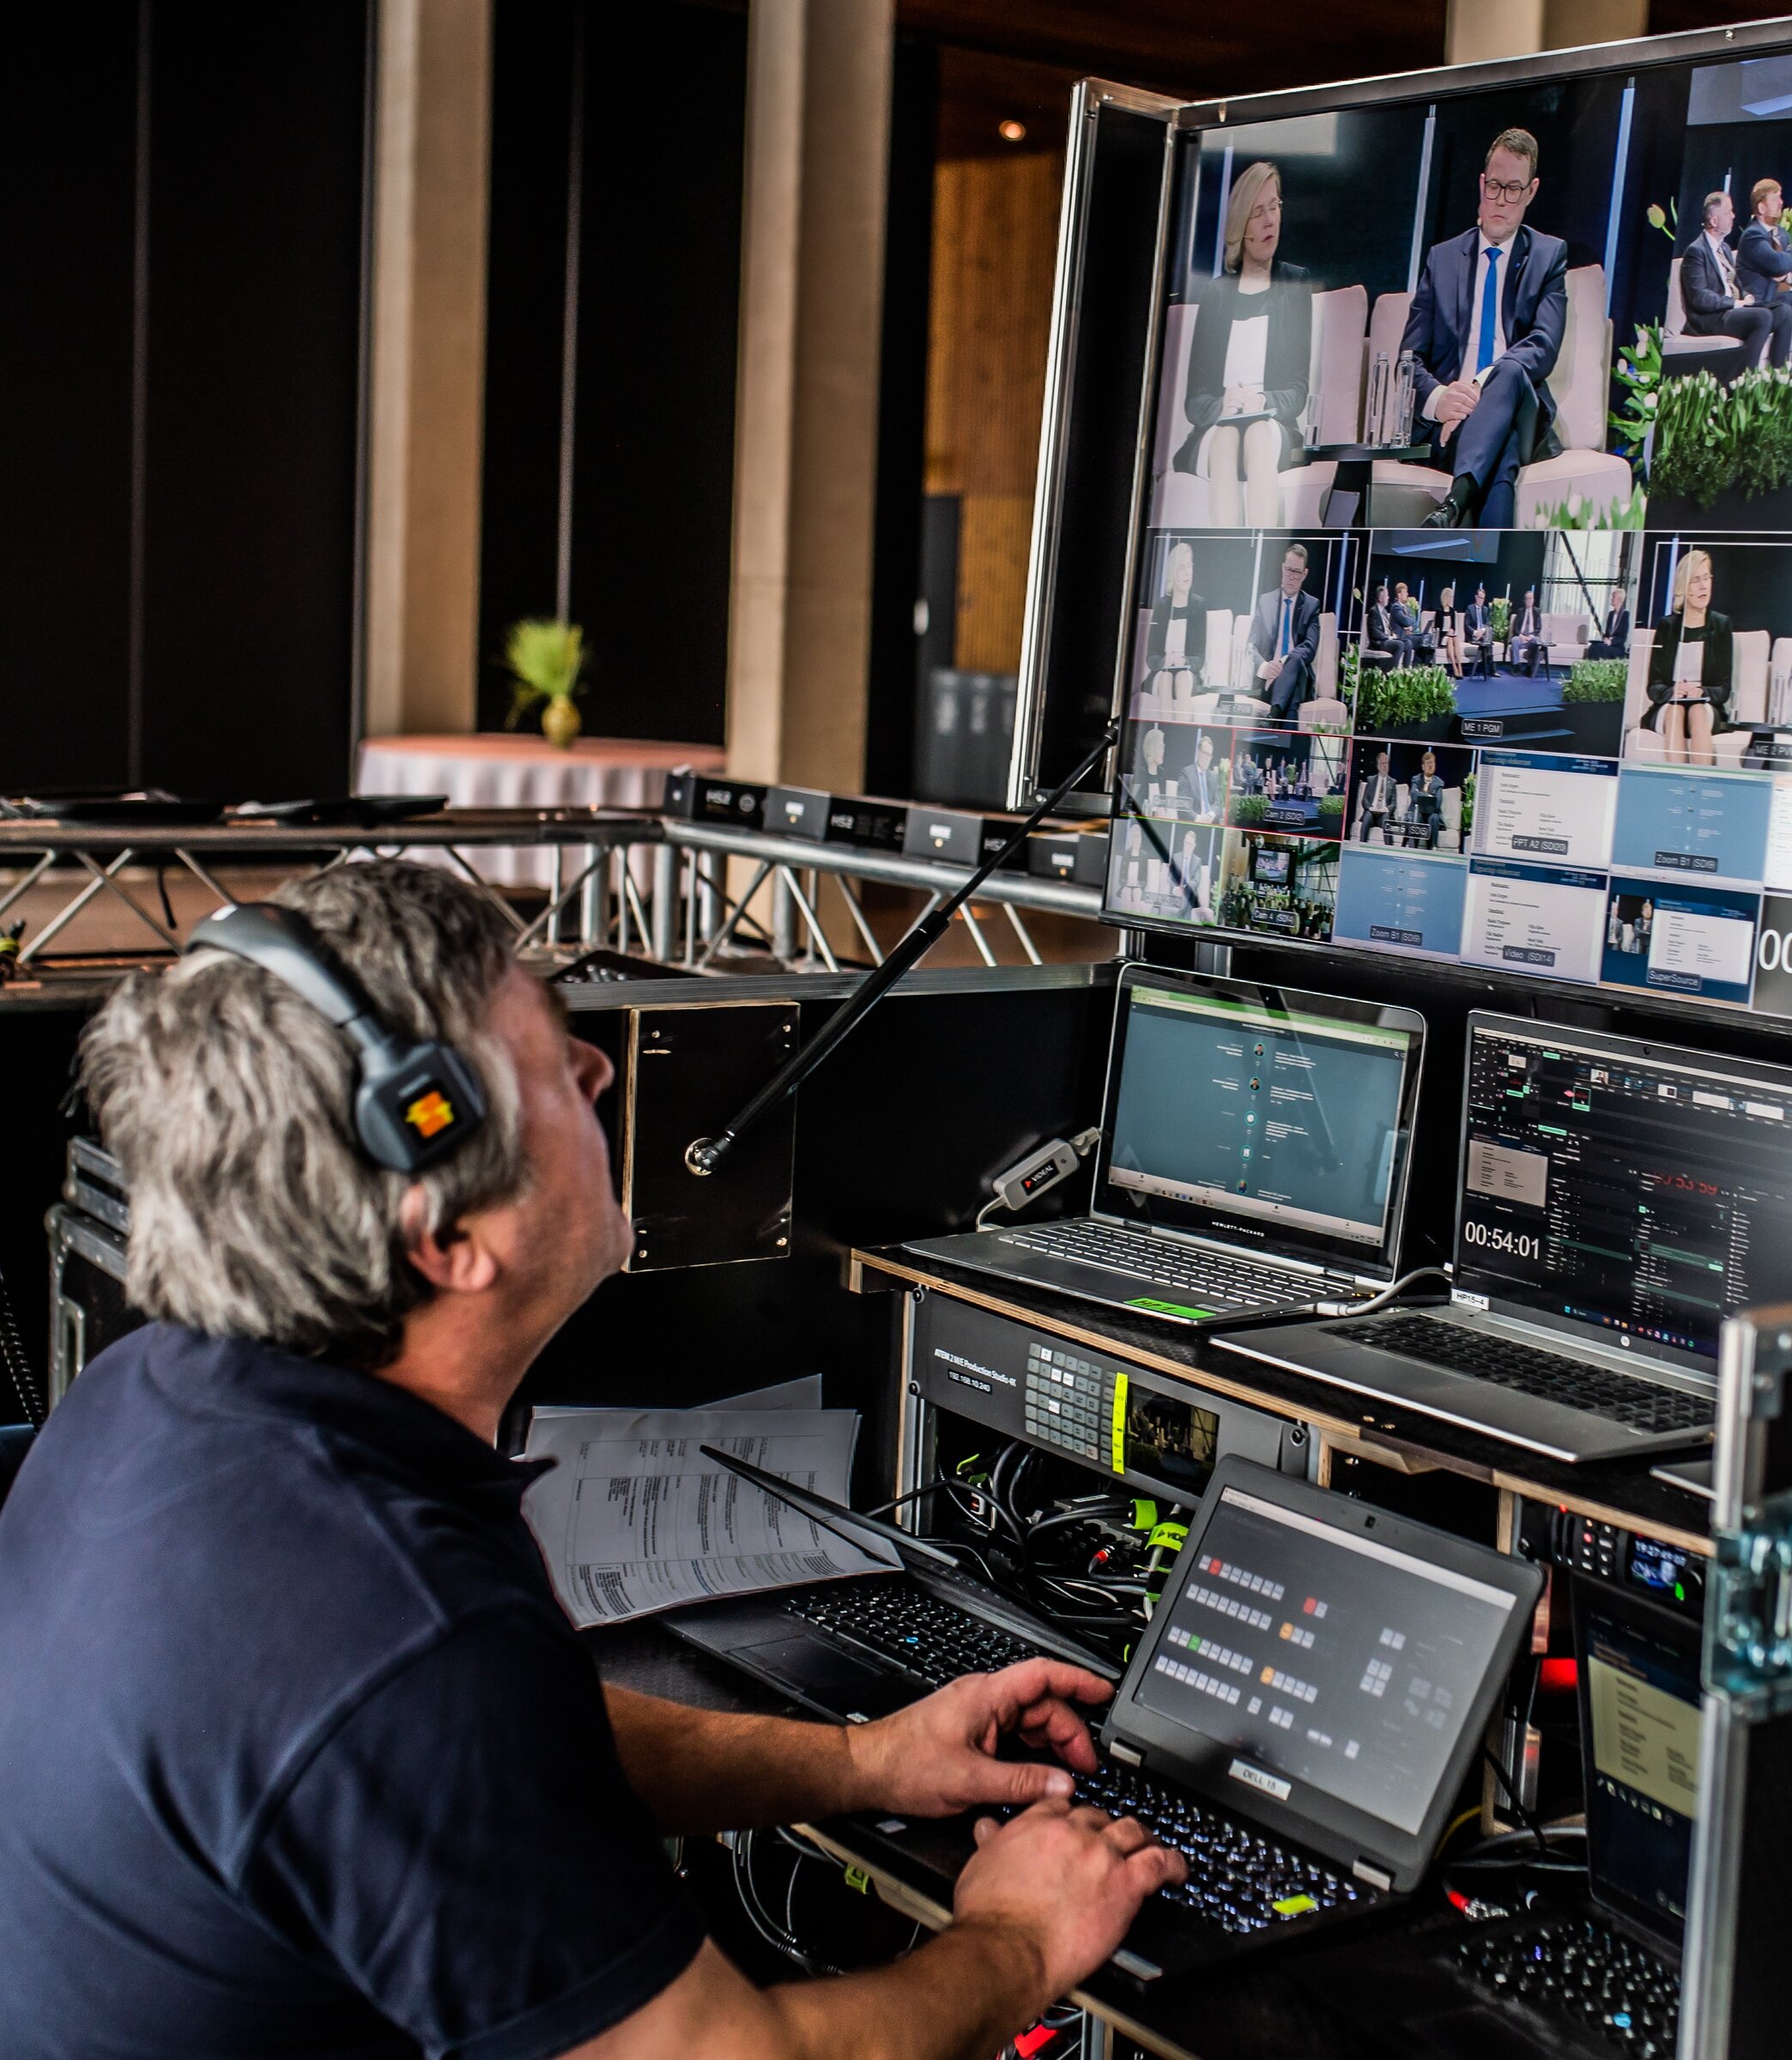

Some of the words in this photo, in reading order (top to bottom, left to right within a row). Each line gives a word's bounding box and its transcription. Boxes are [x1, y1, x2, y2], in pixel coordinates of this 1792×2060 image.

[1463, 723, 1475, 731] ME
[1482, 724, 1500, 734] PGM
[1755, 745, 1769, 754] ME
[1771, 747, 1777, 755] 2
[1264, 809, 1279, 818] Cam
[1384, 823, 1400, 833] Cam
[1400, 825, 1406, 833] 5
[1513, 837, 1529, 847] PPT
[1529, 839, 1540, 849] A2
[1656, 854, 1678, 865] Zoom
[1680, 856, 1690, 866] B1
[1254, 910, 1268, 919] Cam
[1371, 928, 1389, 938] Zoom
[1390, 930, 1400, 939] B1
[1504, 948, 1524, 960] Video
[1649, 969, 1699, 987] SuperSource
[1211, 1221, 1265, 1238] HEWLETT-PACKARD
[1464, 1221, 1540, 1260] 00:54:01
[1456, 1292, 1485, 1306] HP15-4
[964, 1359, 992, 1377] Production
[991, 1370, 1009, 1384] Studio
[1243, 1768, 1263, 1786] DELL
